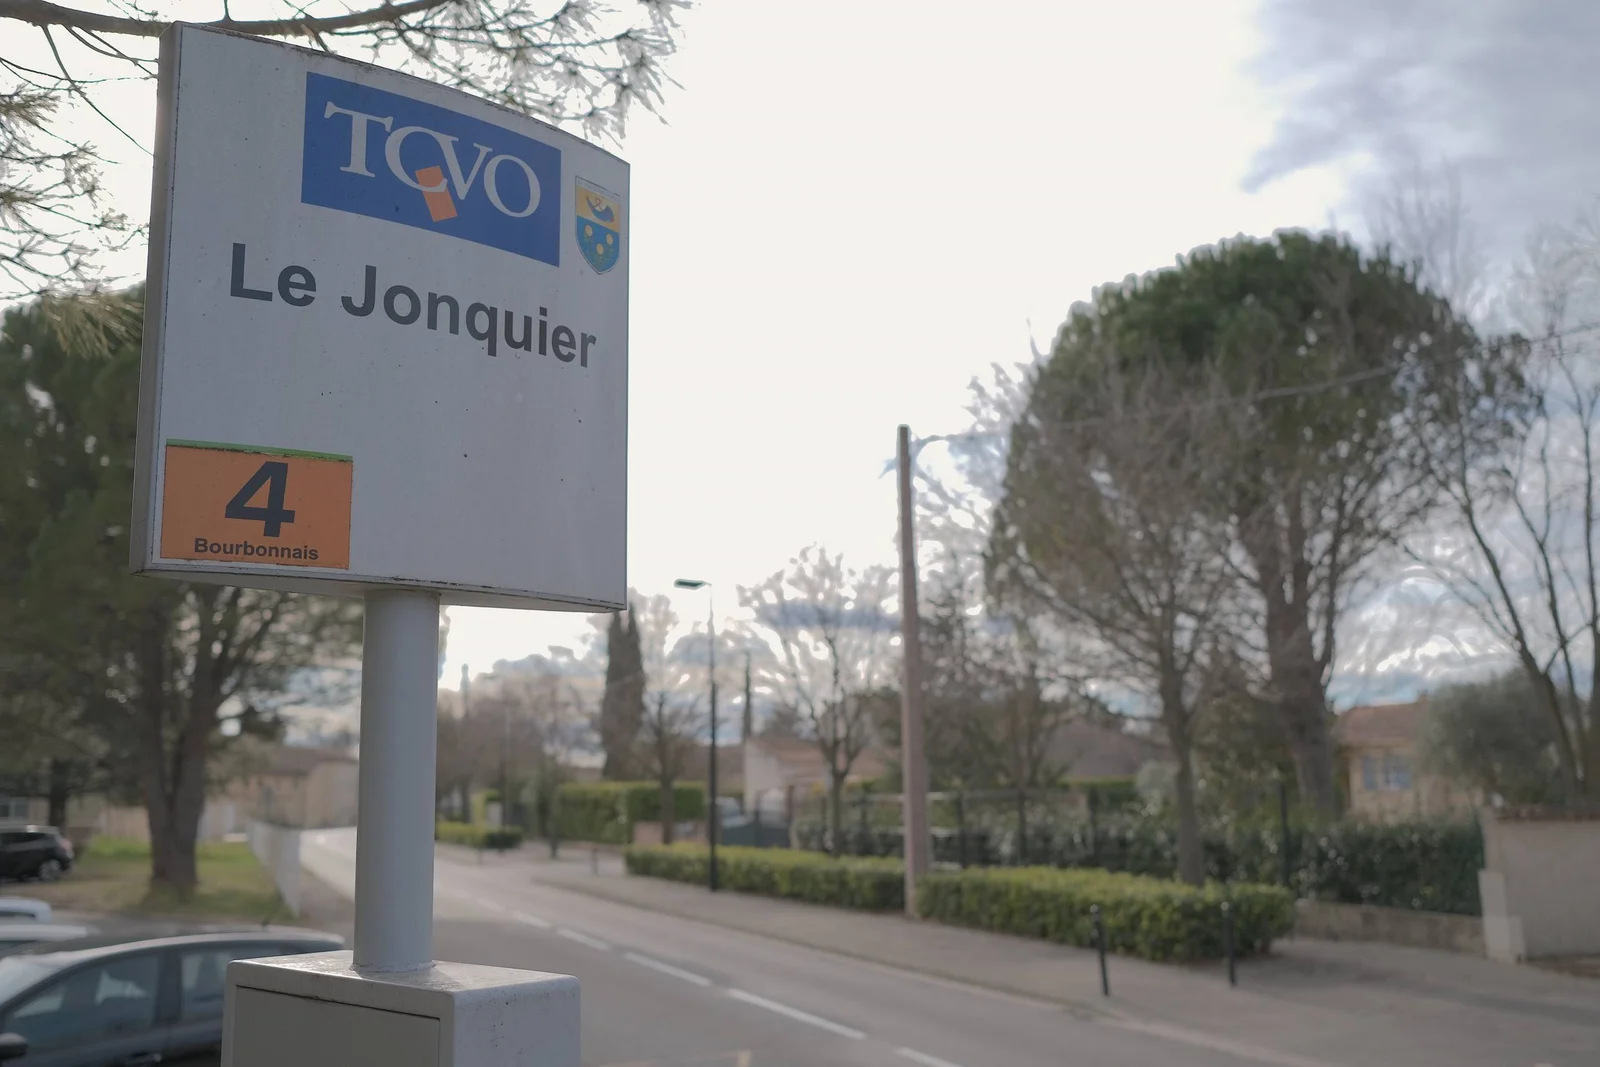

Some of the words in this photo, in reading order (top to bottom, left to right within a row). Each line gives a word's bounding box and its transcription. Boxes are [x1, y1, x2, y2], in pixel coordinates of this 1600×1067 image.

[323, 101, 542, 218] TCVO
[230, 243, 317, 306] Le
[341, 265, 597, 368] Jonquier
[224, 461, 295, 537] 4
[194, 538, 319, 560] Bourbonnais
